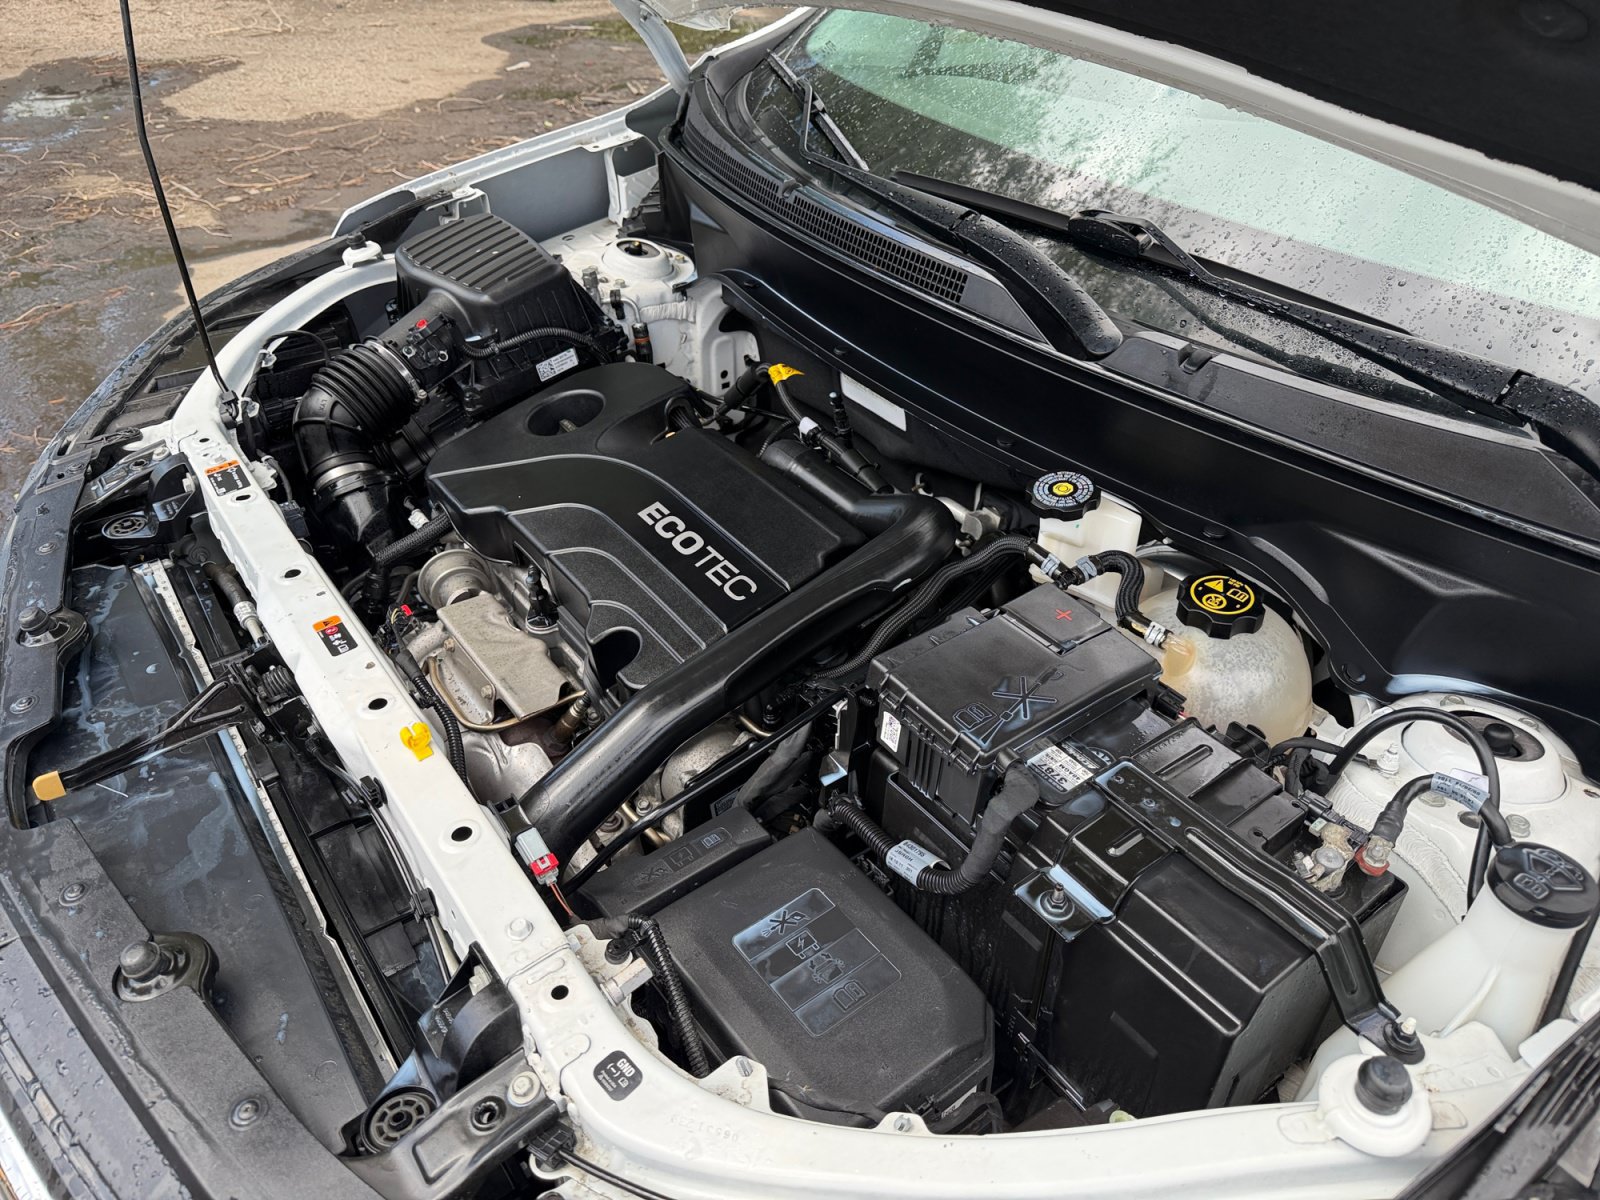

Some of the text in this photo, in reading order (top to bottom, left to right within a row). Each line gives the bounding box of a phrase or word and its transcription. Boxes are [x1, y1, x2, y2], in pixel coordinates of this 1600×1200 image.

[637, 501, 757, 601] ECOTEC
[1038, 763, 1067, 785] 3787
[617, 1058, 635, 1077] GND
